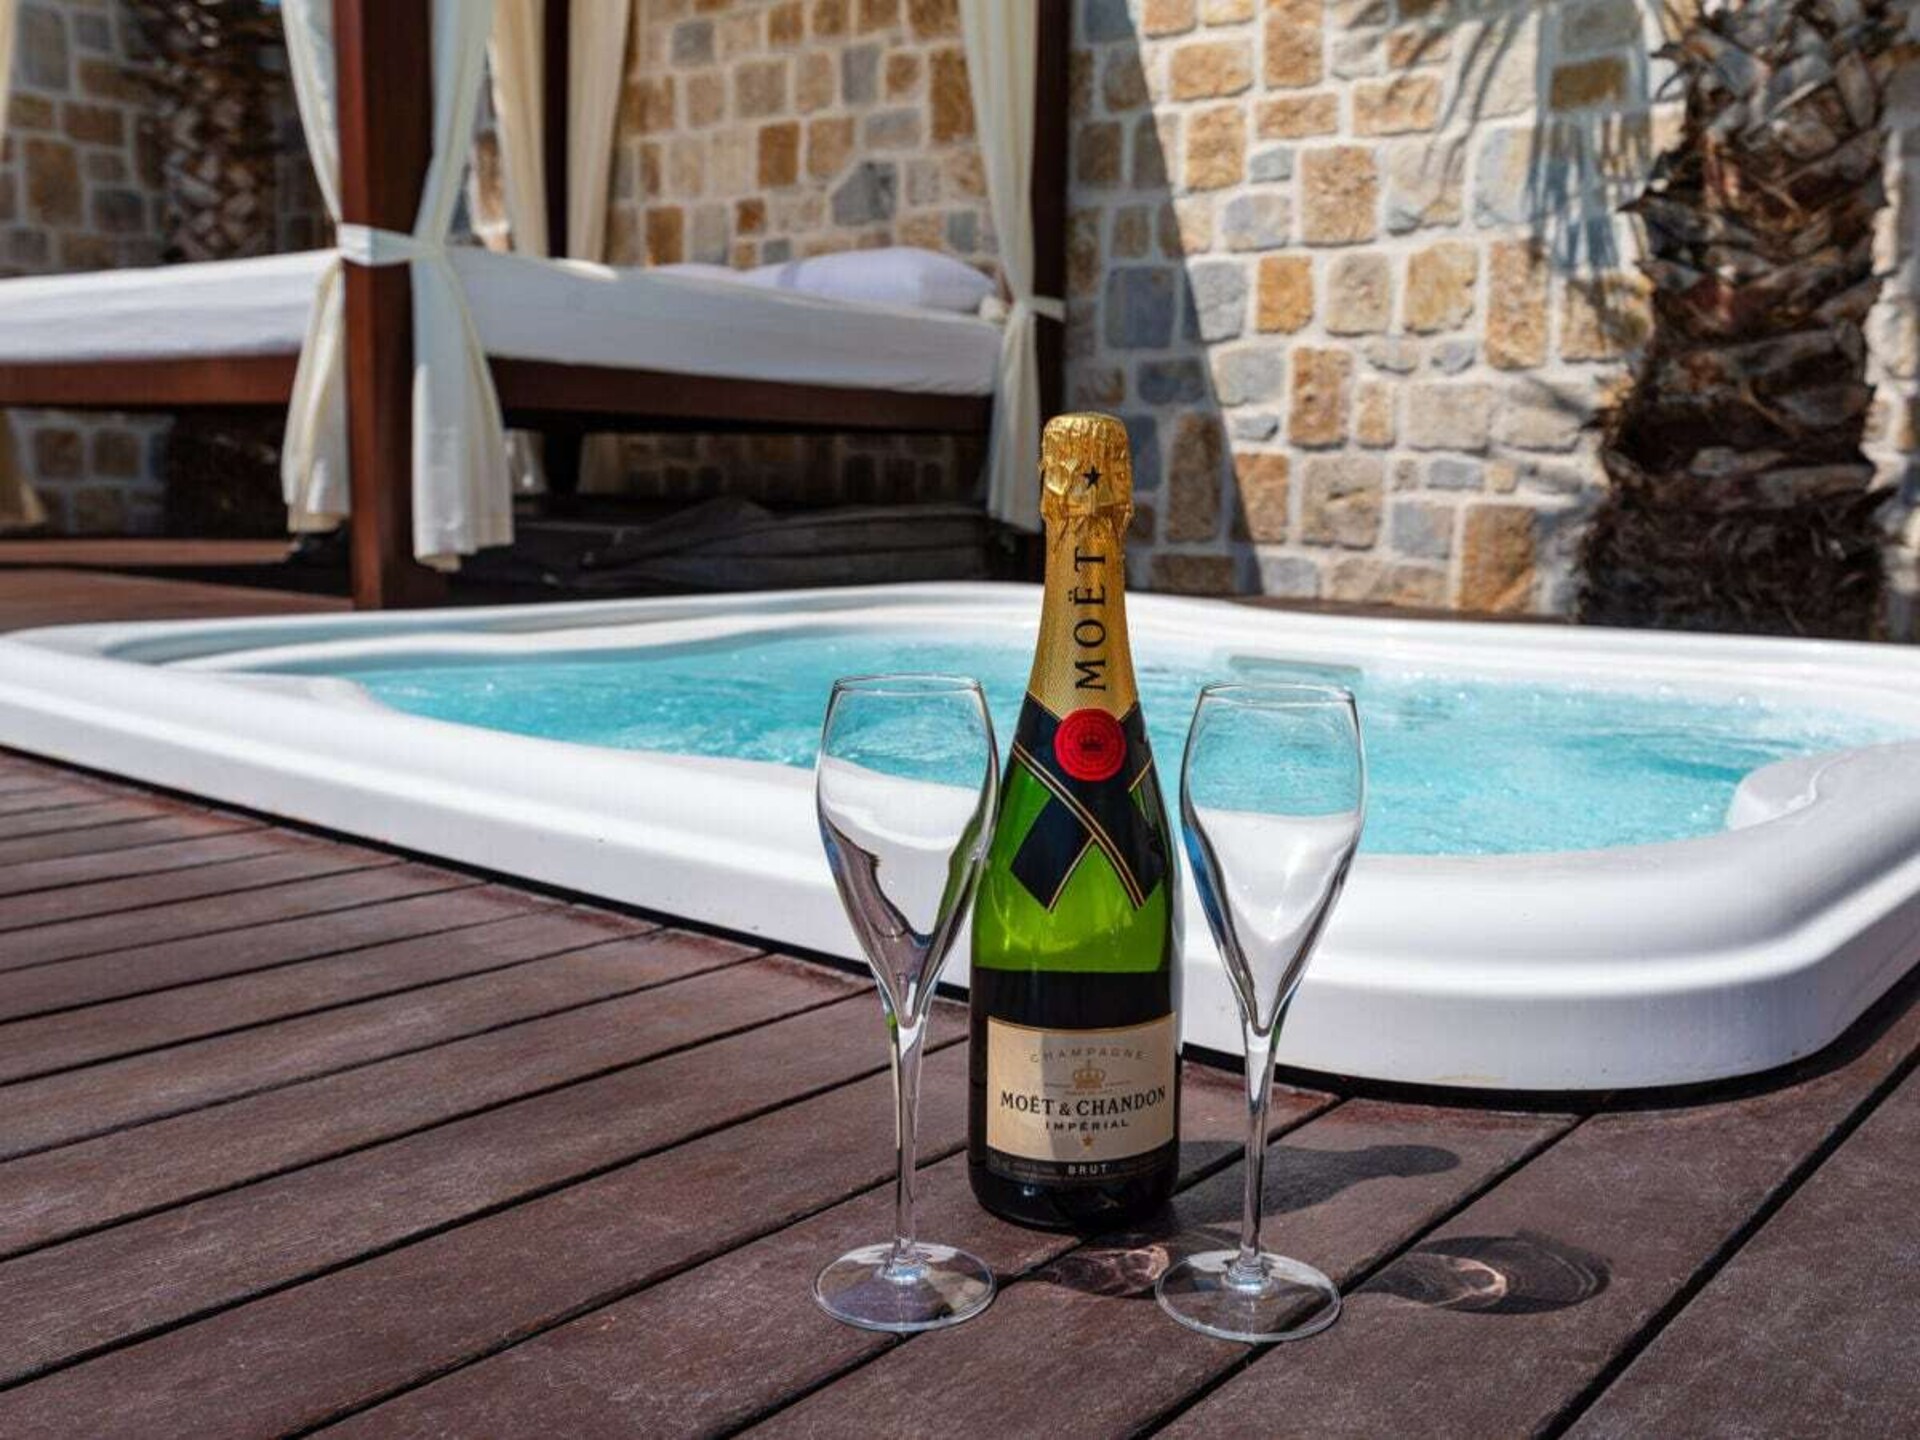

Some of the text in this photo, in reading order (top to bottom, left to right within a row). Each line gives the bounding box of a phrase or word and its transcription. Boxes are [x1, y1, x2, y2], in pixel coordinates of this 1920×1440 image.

[1068, 546, 1106, 691] MOËT
[1030, 1047, 1147, 1063] CHAMPAGNE
[1001, 1086, 1166, 1116] MOËT & CHANDON
[1046, 1119, 1129, 1131] IMPÉRIAL
[1068, 1164, 1107, 1176] BRUT
